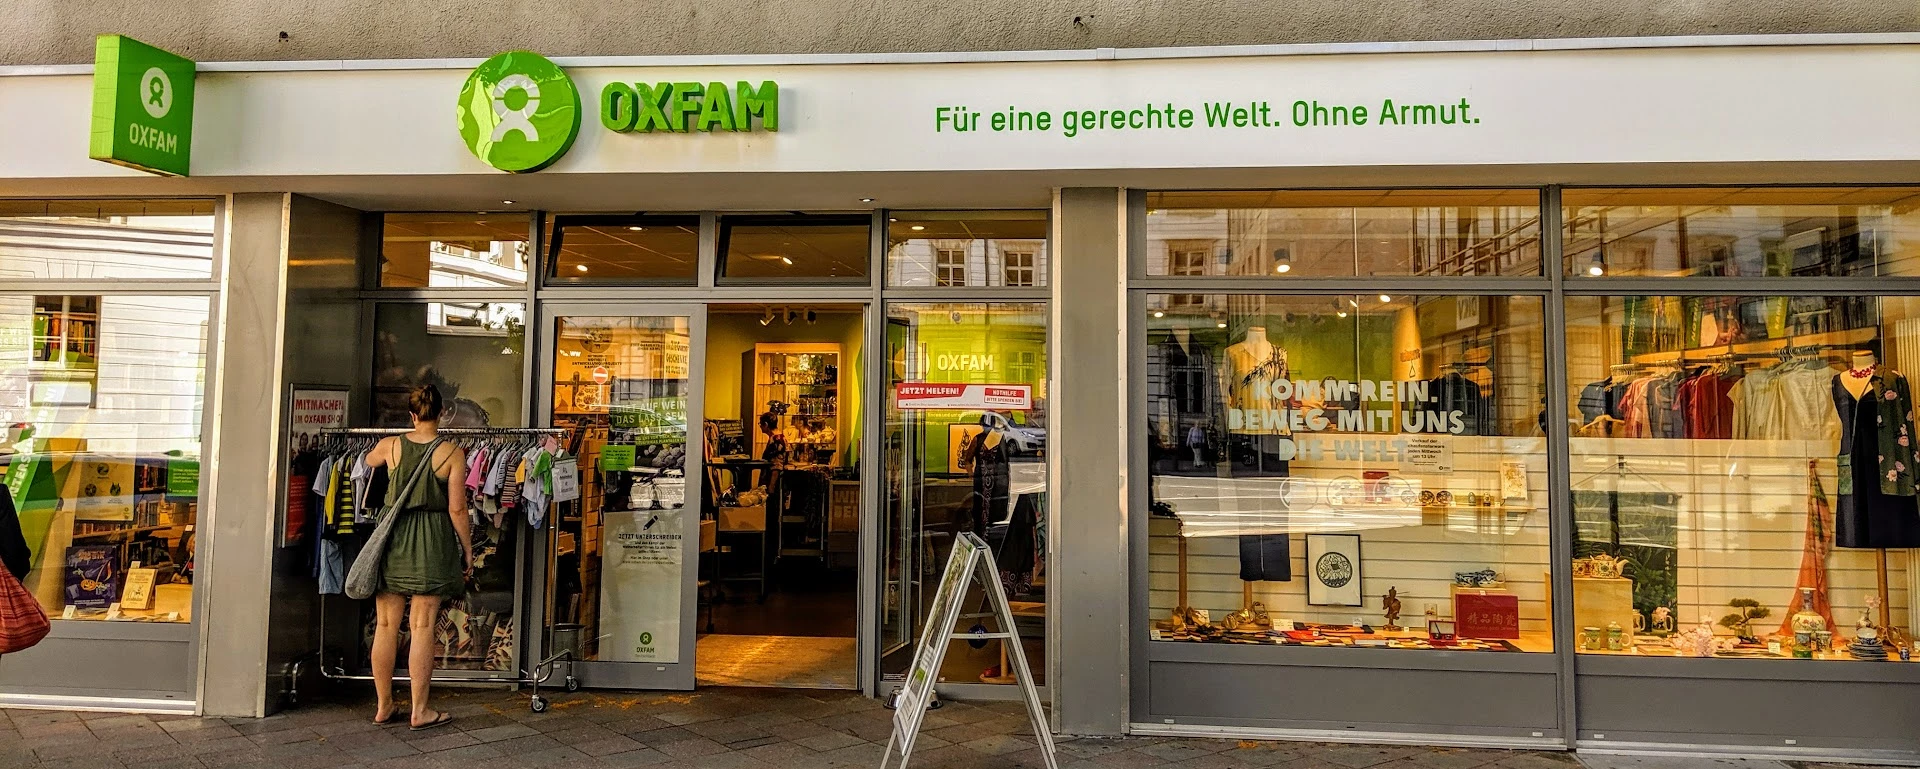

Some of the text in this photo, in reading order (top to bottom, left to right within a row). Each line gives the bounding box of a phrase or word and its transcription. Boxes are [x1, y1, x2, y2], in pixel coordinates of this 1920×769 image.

[600, 81, 779, 133] OXFAM
[936, 98, 1480, 137] Für eine gerechte Welt. Ohne Armut.
[129, 123, 177, 155] OXFAM
[937, 354, 994, 371] OXFAM
[900, 387, 960, 395] JETZT HELFEN!
[1253, 379, 1438, 403] KOMM REIN.
[295, 399, 344, 410] MITMACHEN
[640, 402, 658, 411] AUF
[661, 400, 686, 410] WEIN
[616, 415, 635, 424] DAS
[638, 413, 662, 422] LASS
[1228, 408, 1465, 434] BEWEG MIT UNS
[1278, 438, 1325, 461] DIE
